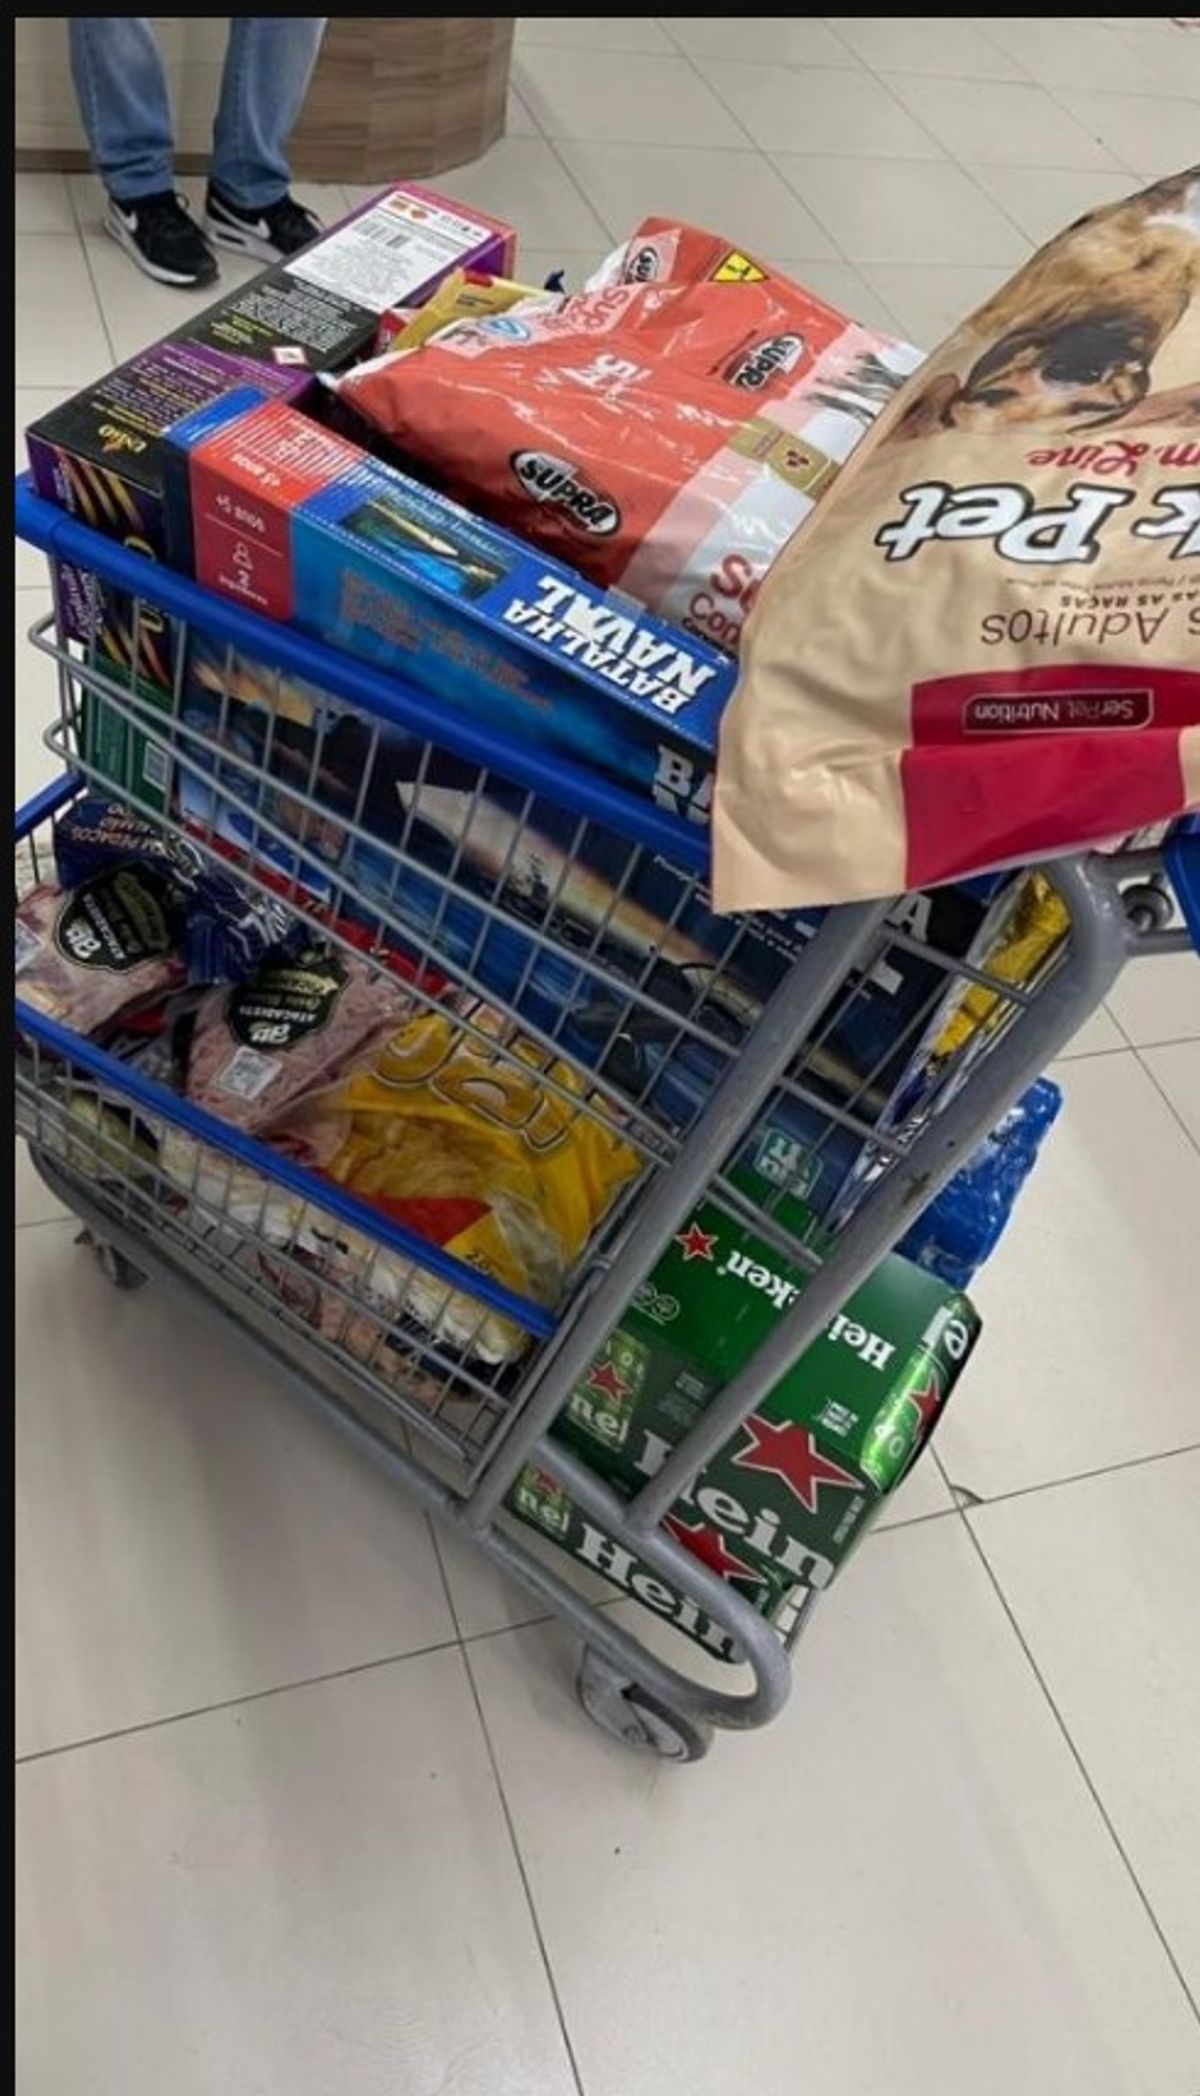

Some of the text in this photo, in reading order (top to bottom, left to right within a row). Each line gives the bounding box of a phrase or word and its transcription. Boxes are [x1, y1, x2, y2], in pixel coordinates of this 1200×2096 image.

[1027, 441, 1148, 476] Line
[518, 461, 615, 526] SUPRA
[875, 480, 1136, 564] Pet
[503, 600, 690, 714] BATALHA
[537, 575, 716, 696] NAVAL
[981, 608, 1169, 647] Adultos
[975, 701, 1060, 721] Nutrition
